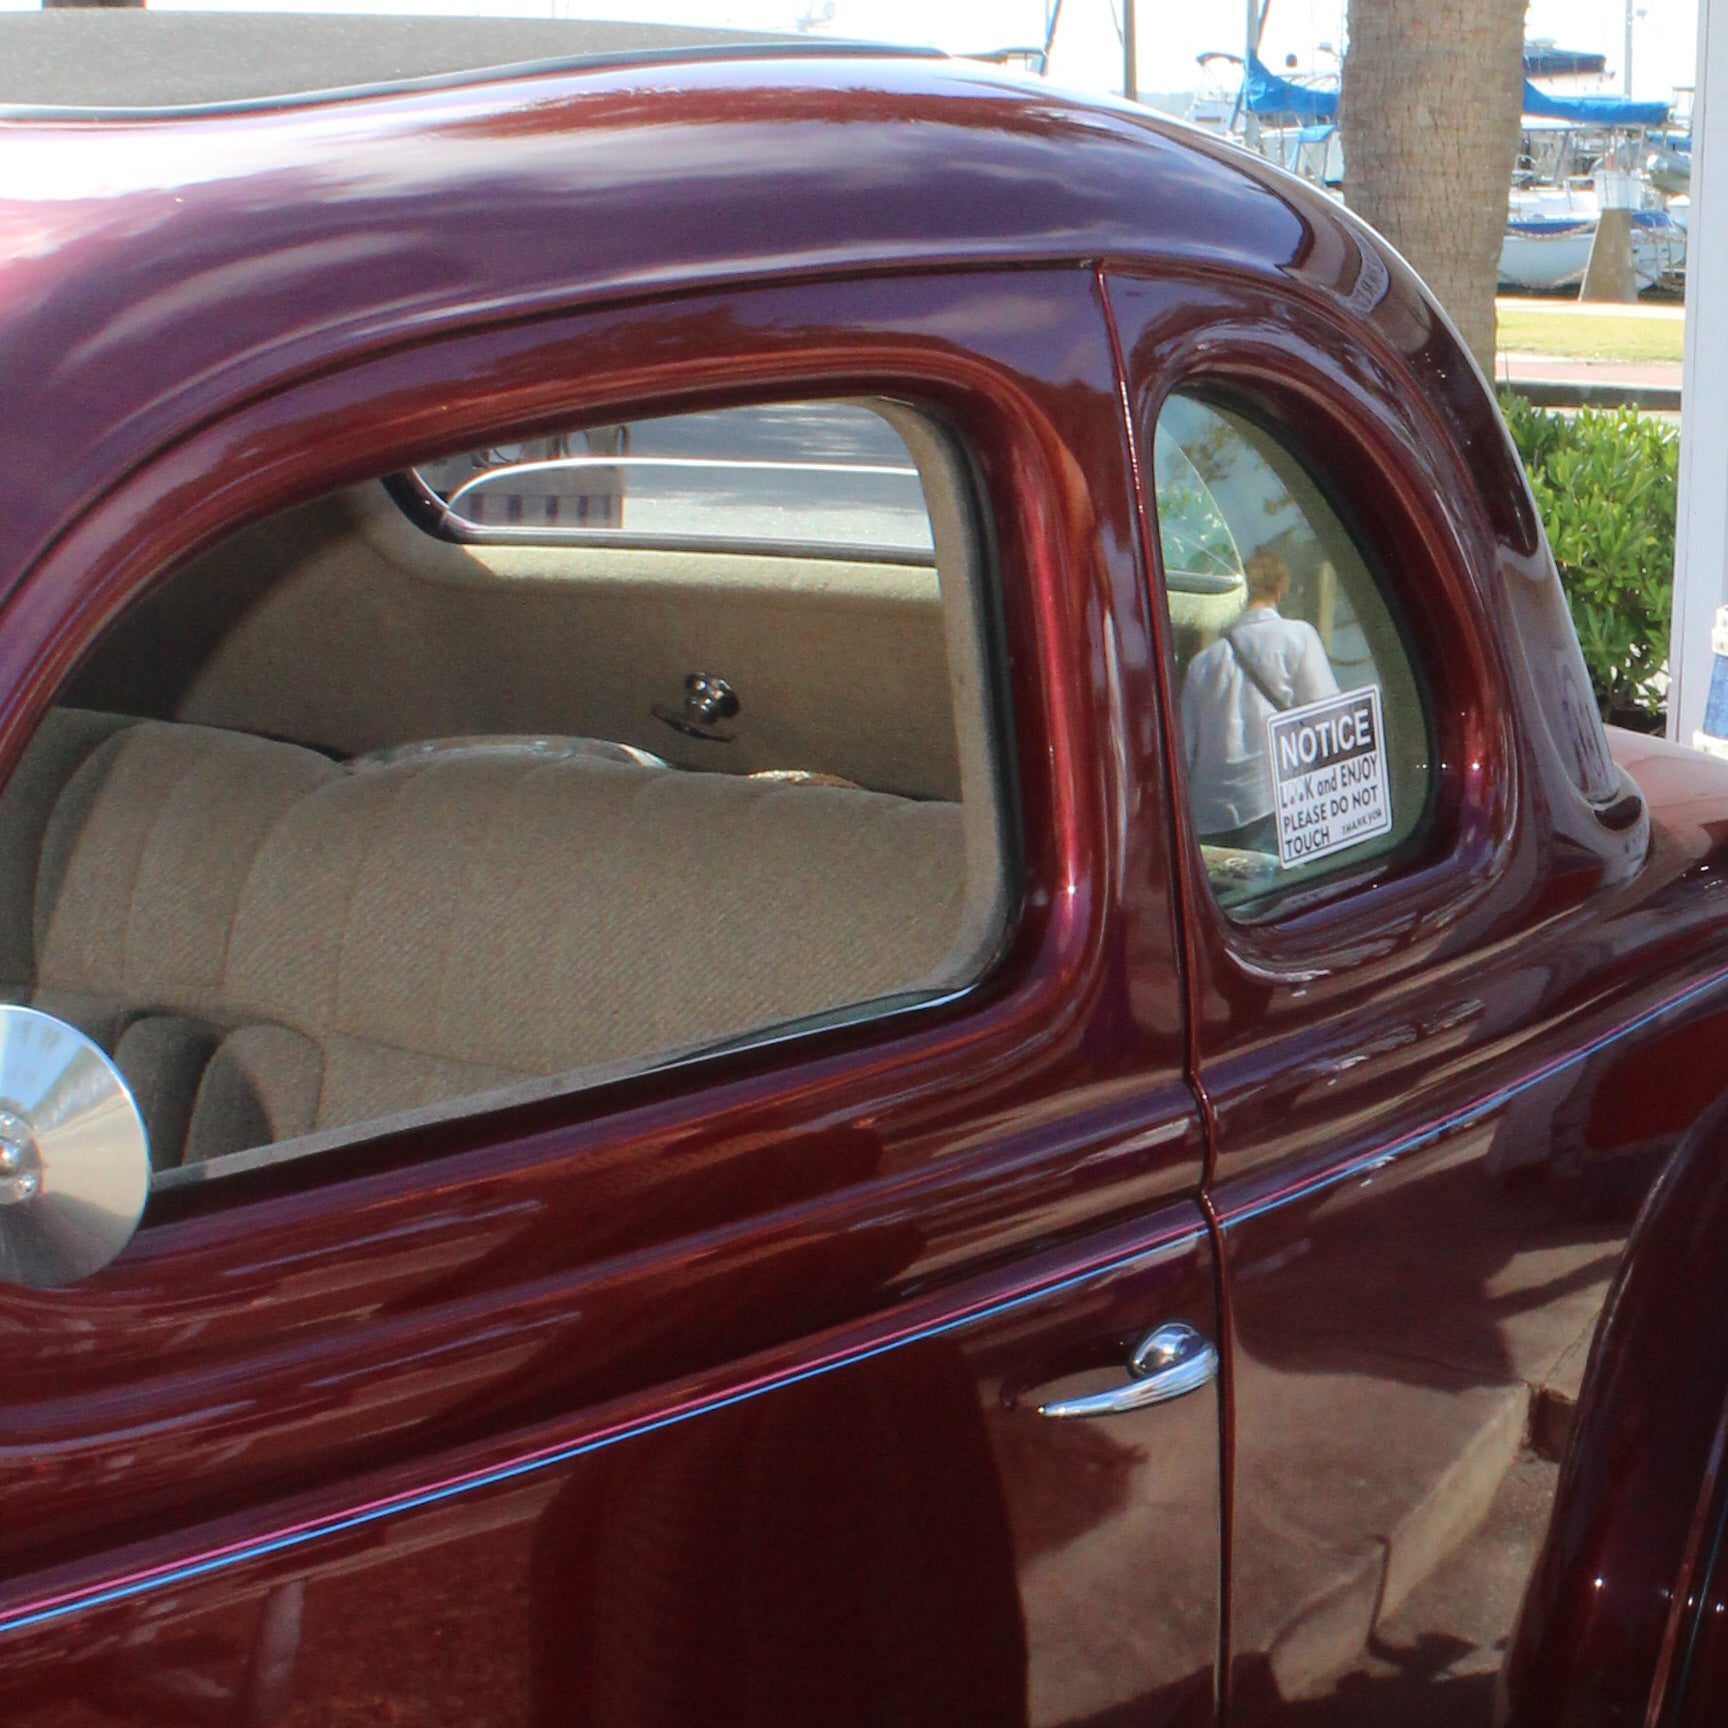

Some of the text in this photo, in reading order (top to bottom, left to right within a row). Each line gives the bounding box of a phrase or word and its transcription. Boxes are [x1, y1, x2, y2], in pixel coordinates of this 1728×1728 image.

[1280, 708, 1373, 771] NOTICE
[1316, 770, 1338, 797] and
[1341, 753, 1379, 789] ENJOY
[1283, 784, 1379, 836] PLEASE DO NOT
[1285, 824, 1331, 859] TOUCH
